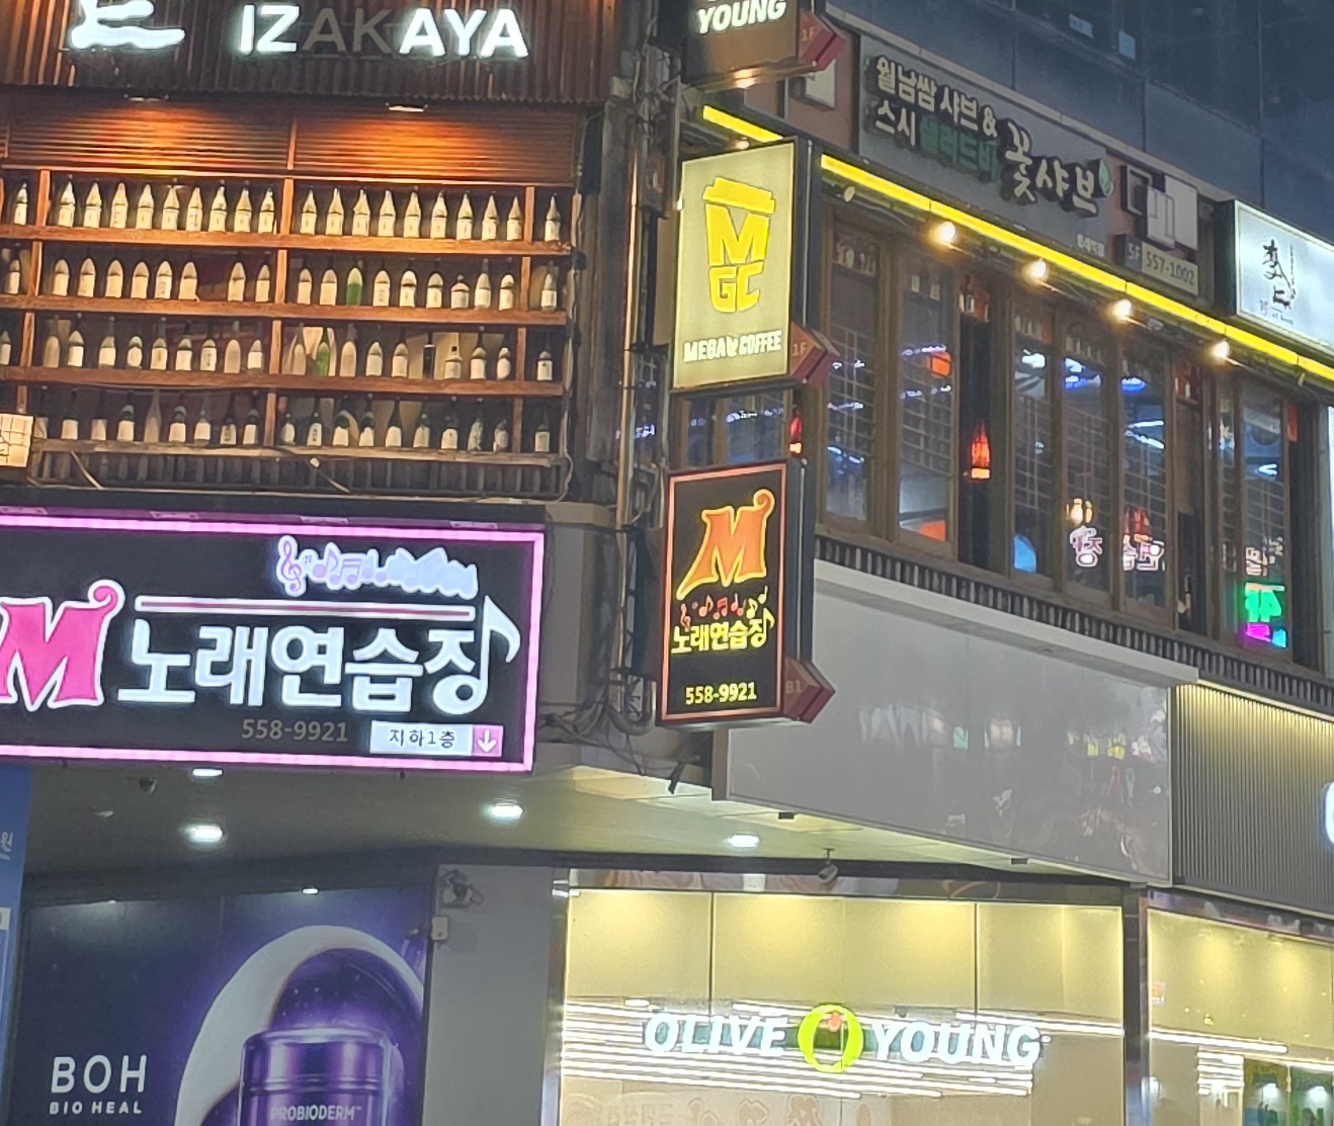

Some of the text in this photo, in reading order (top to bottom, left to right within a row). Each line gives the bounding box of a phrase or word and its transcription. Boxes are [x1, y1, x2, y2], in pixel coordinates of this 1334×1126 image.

[239, 4, 529, 59] IZAKAYA
[875, 99, 916, 147] 스시
[940, 85, 979, 132] 샤브
[1005, 121, 1099, 216] 꽃샤브
[738, 330, 782, 357] COFFEE
[670, 607, 776, 655] 노래연습장
[117, 595, 521, 716] 노래연습장
[685, 681, 758, 706] 558-9921
[241, 718, 349, 743] 558-9921
[387, 726, 457, 750] 지하1층
[644, 1012, 787, 1057] OLIVE
[871, 1022, 1043, 1066] YOUNG
[49, 1054, 148, 1094] BOH
[49, 1099, 143, 1116] BIO HEAL
